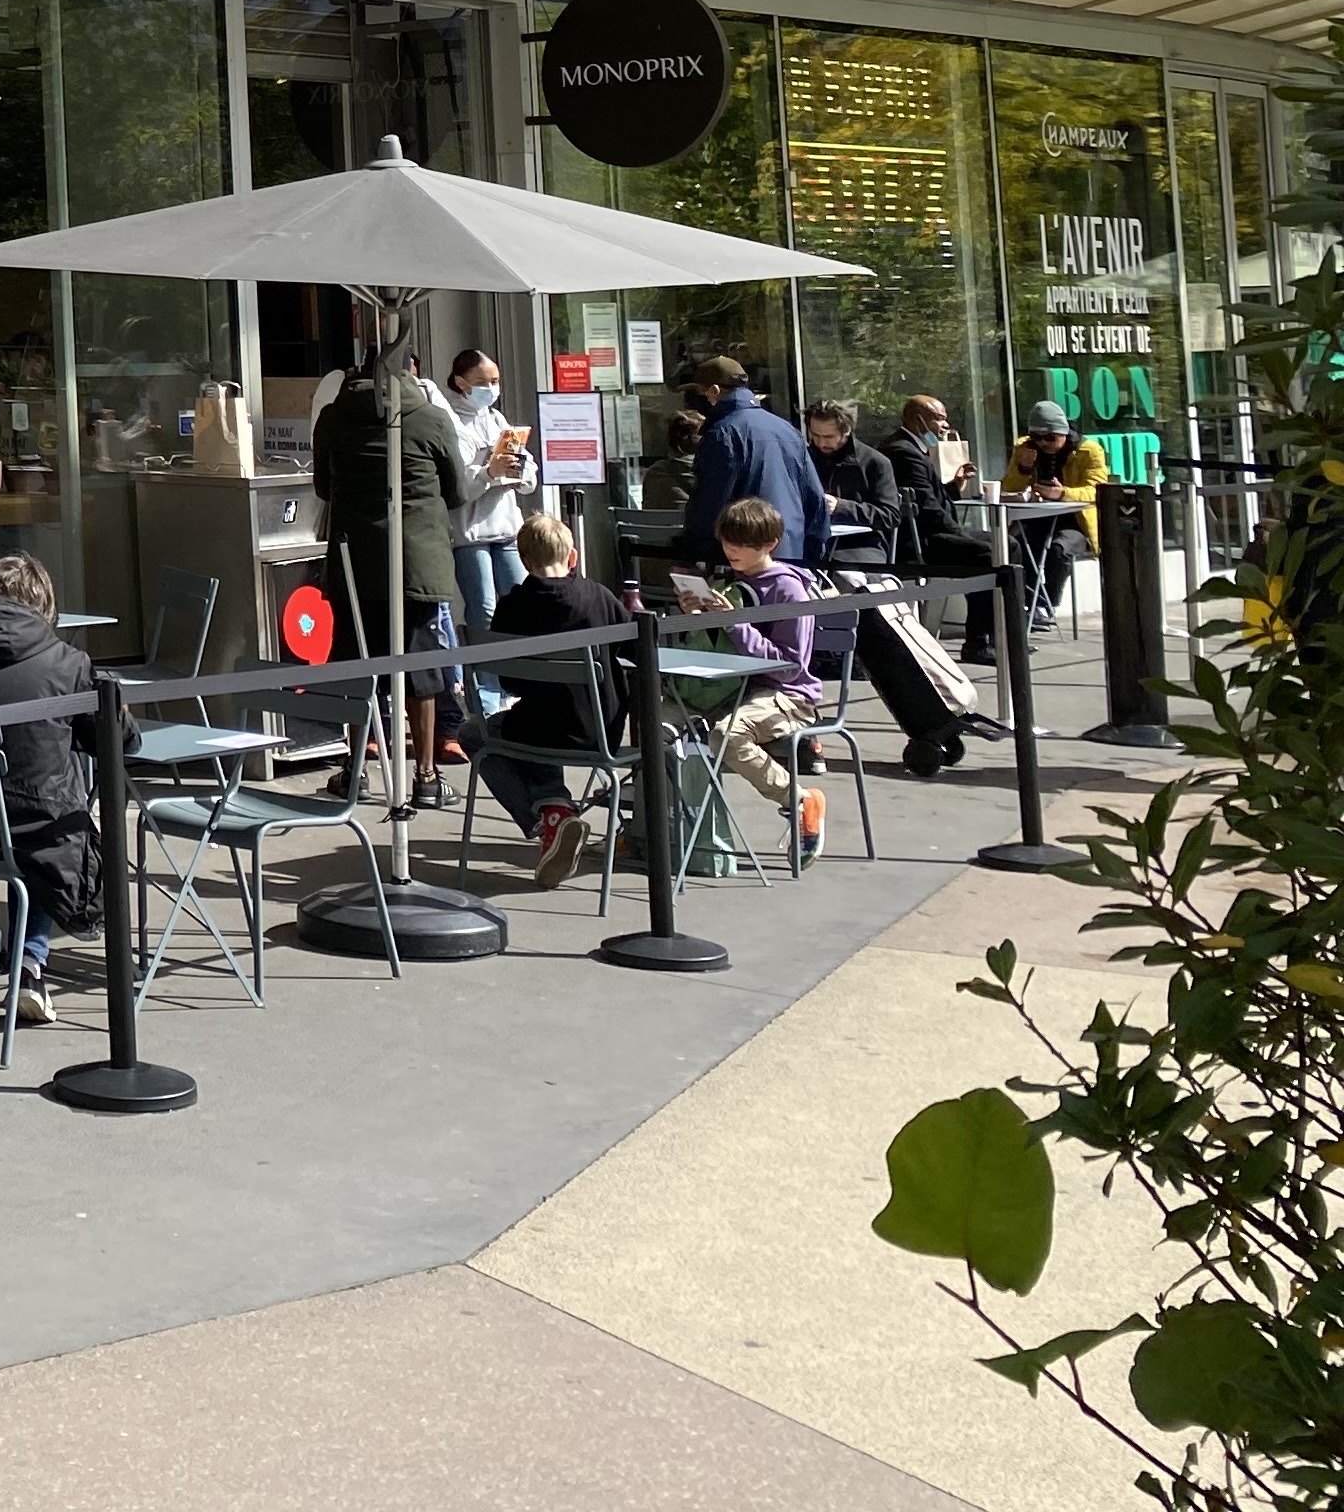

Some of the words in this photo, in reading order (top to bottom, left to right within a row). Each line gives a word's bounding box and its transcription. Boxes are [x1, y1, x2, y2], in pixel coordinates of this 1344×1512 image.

[559, 55, 705, 88] MONOPRIX
[1041, 111, 1129, 157] CHAMPEAUX
[1039, 213, 1146, 276] L'AVENIR
[1046, 285, 1108, 314] APPARTIENT
[1111, 282, 1122, 314] À
[1122, 286, 1150, 314] CEUX
[1046, 325, 1068, 356] QUI
[1070, 325, 1086, 354] SE
[1090, 320, 1133, 354] LÈVENT
[1136, 325, 1153, 354] DE
[1044, 365, 1157, 421] BON
